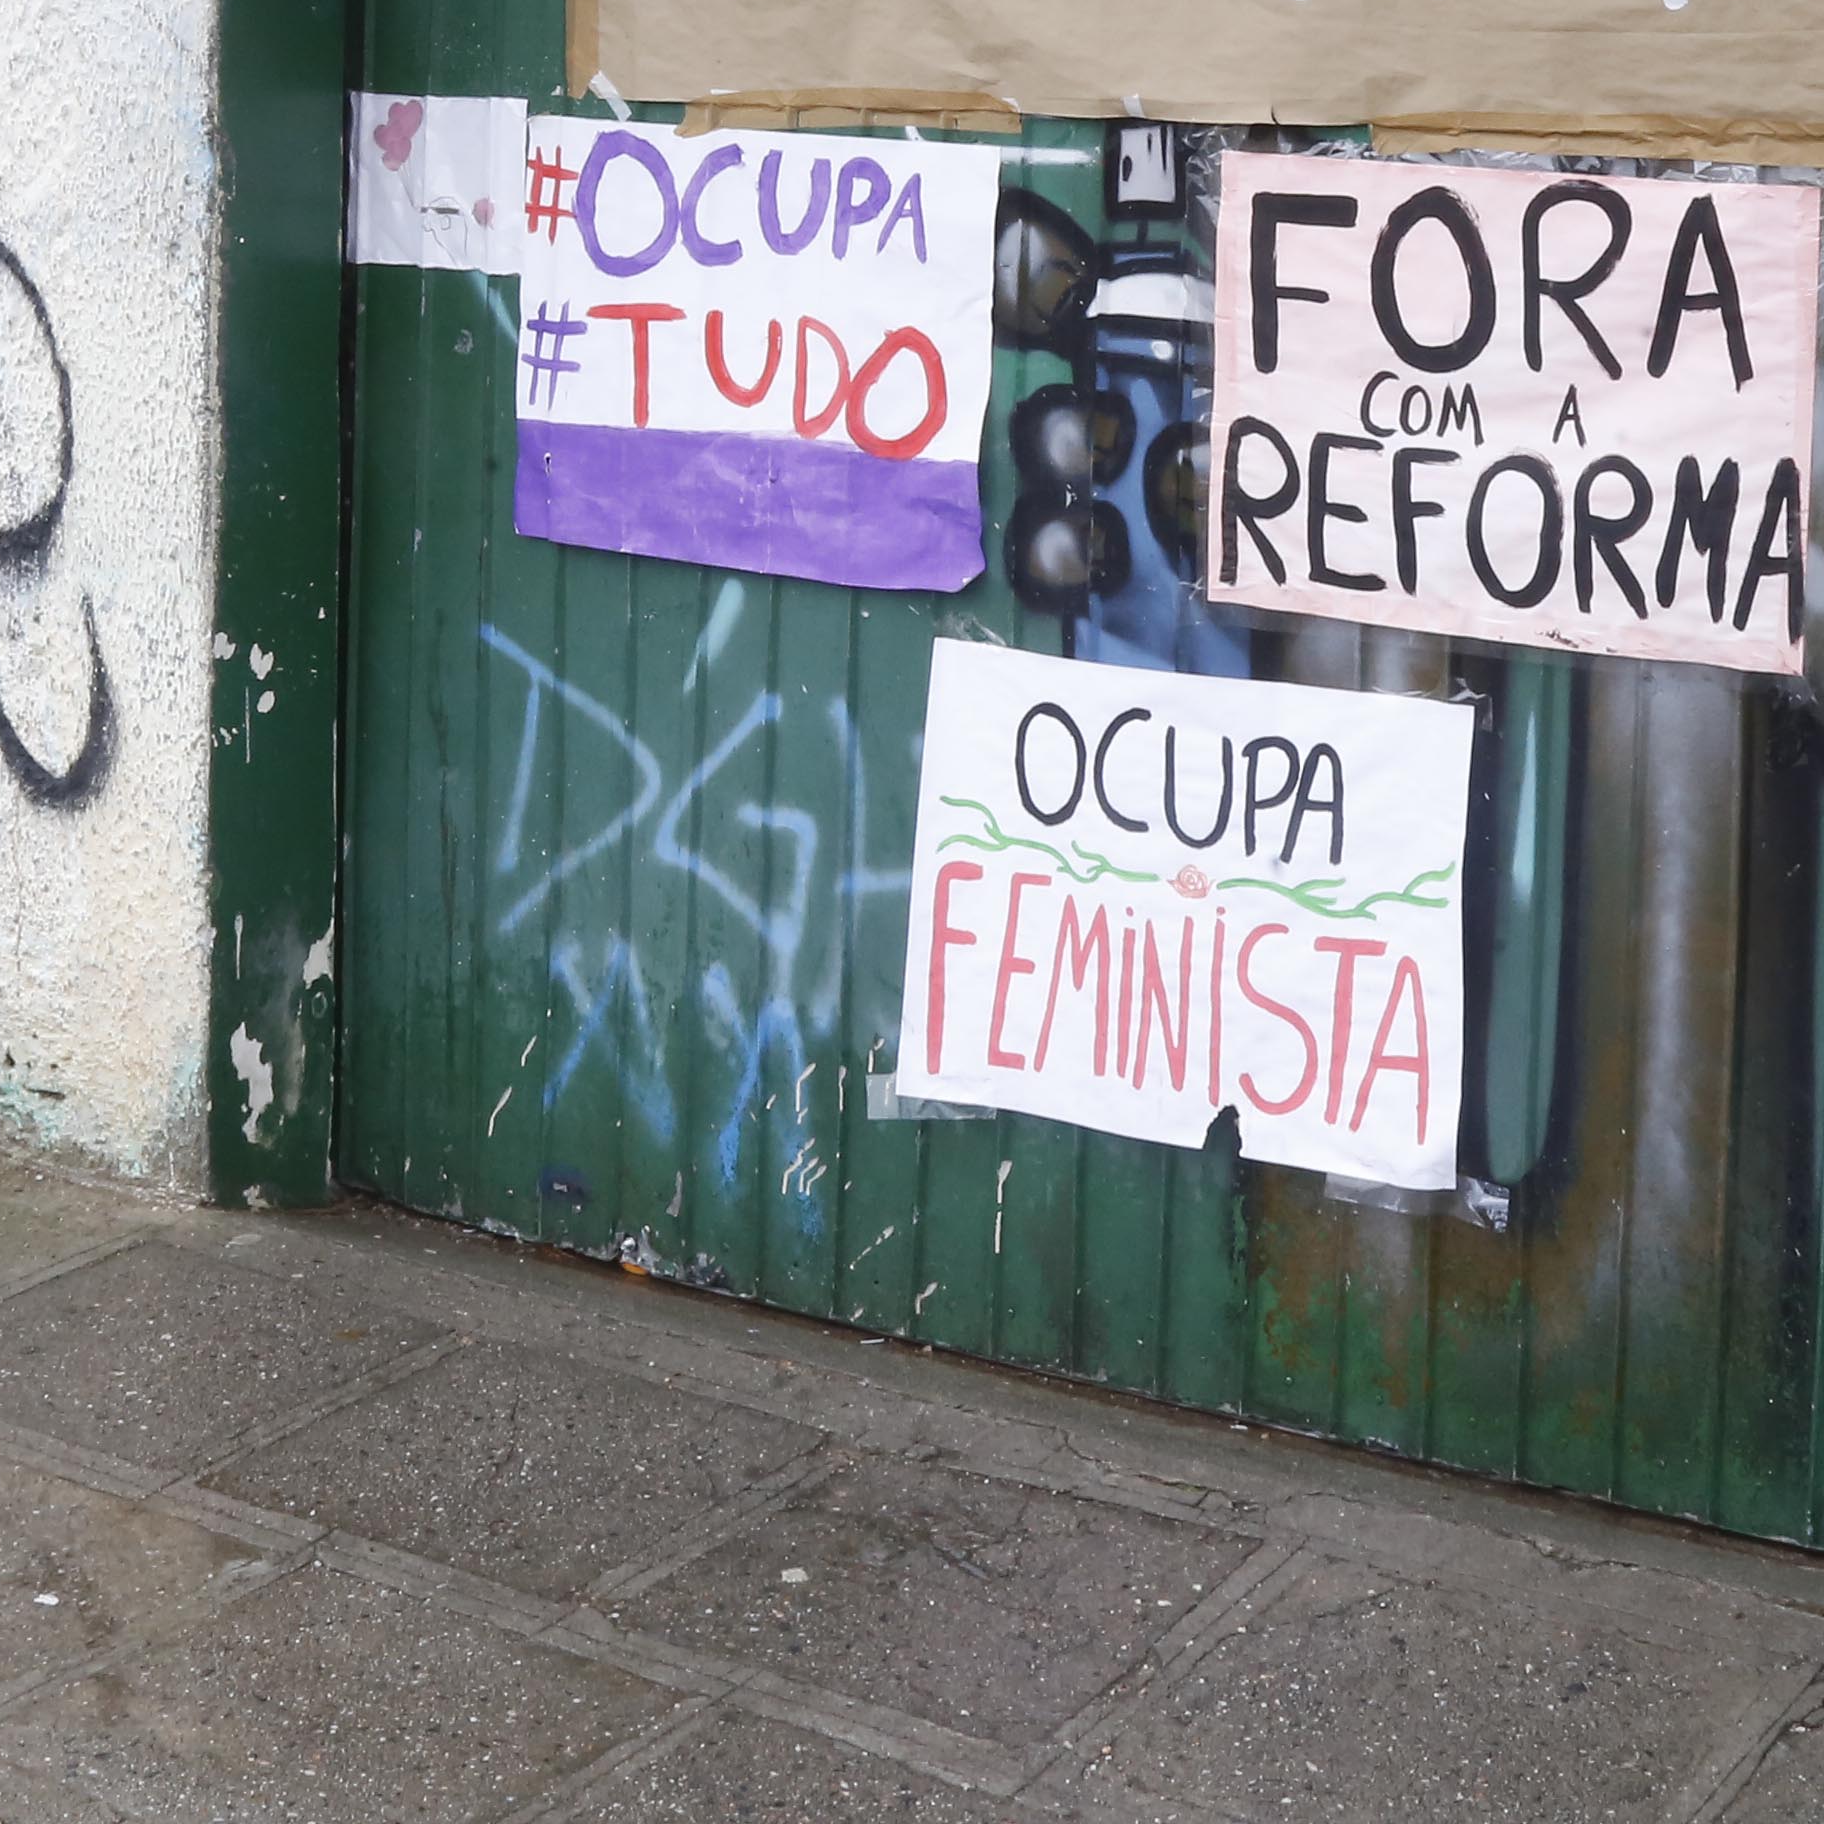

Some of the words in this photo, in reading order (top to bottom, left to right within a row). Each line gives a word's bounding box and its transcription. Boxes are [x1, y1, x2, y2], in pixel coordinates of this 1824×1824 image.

[525, 128, 928, 278] #OCUPA
[1249, 180, 1754, 390] FORA
[523, 299, 949, 460] #TUDO
[1360, 370, 1483, 446] COM
[1551, 383, 1586, 447] A
[1219, 415, 1807, 647] REFORMA
[1014, 700, 1346, 865] OCUPA
